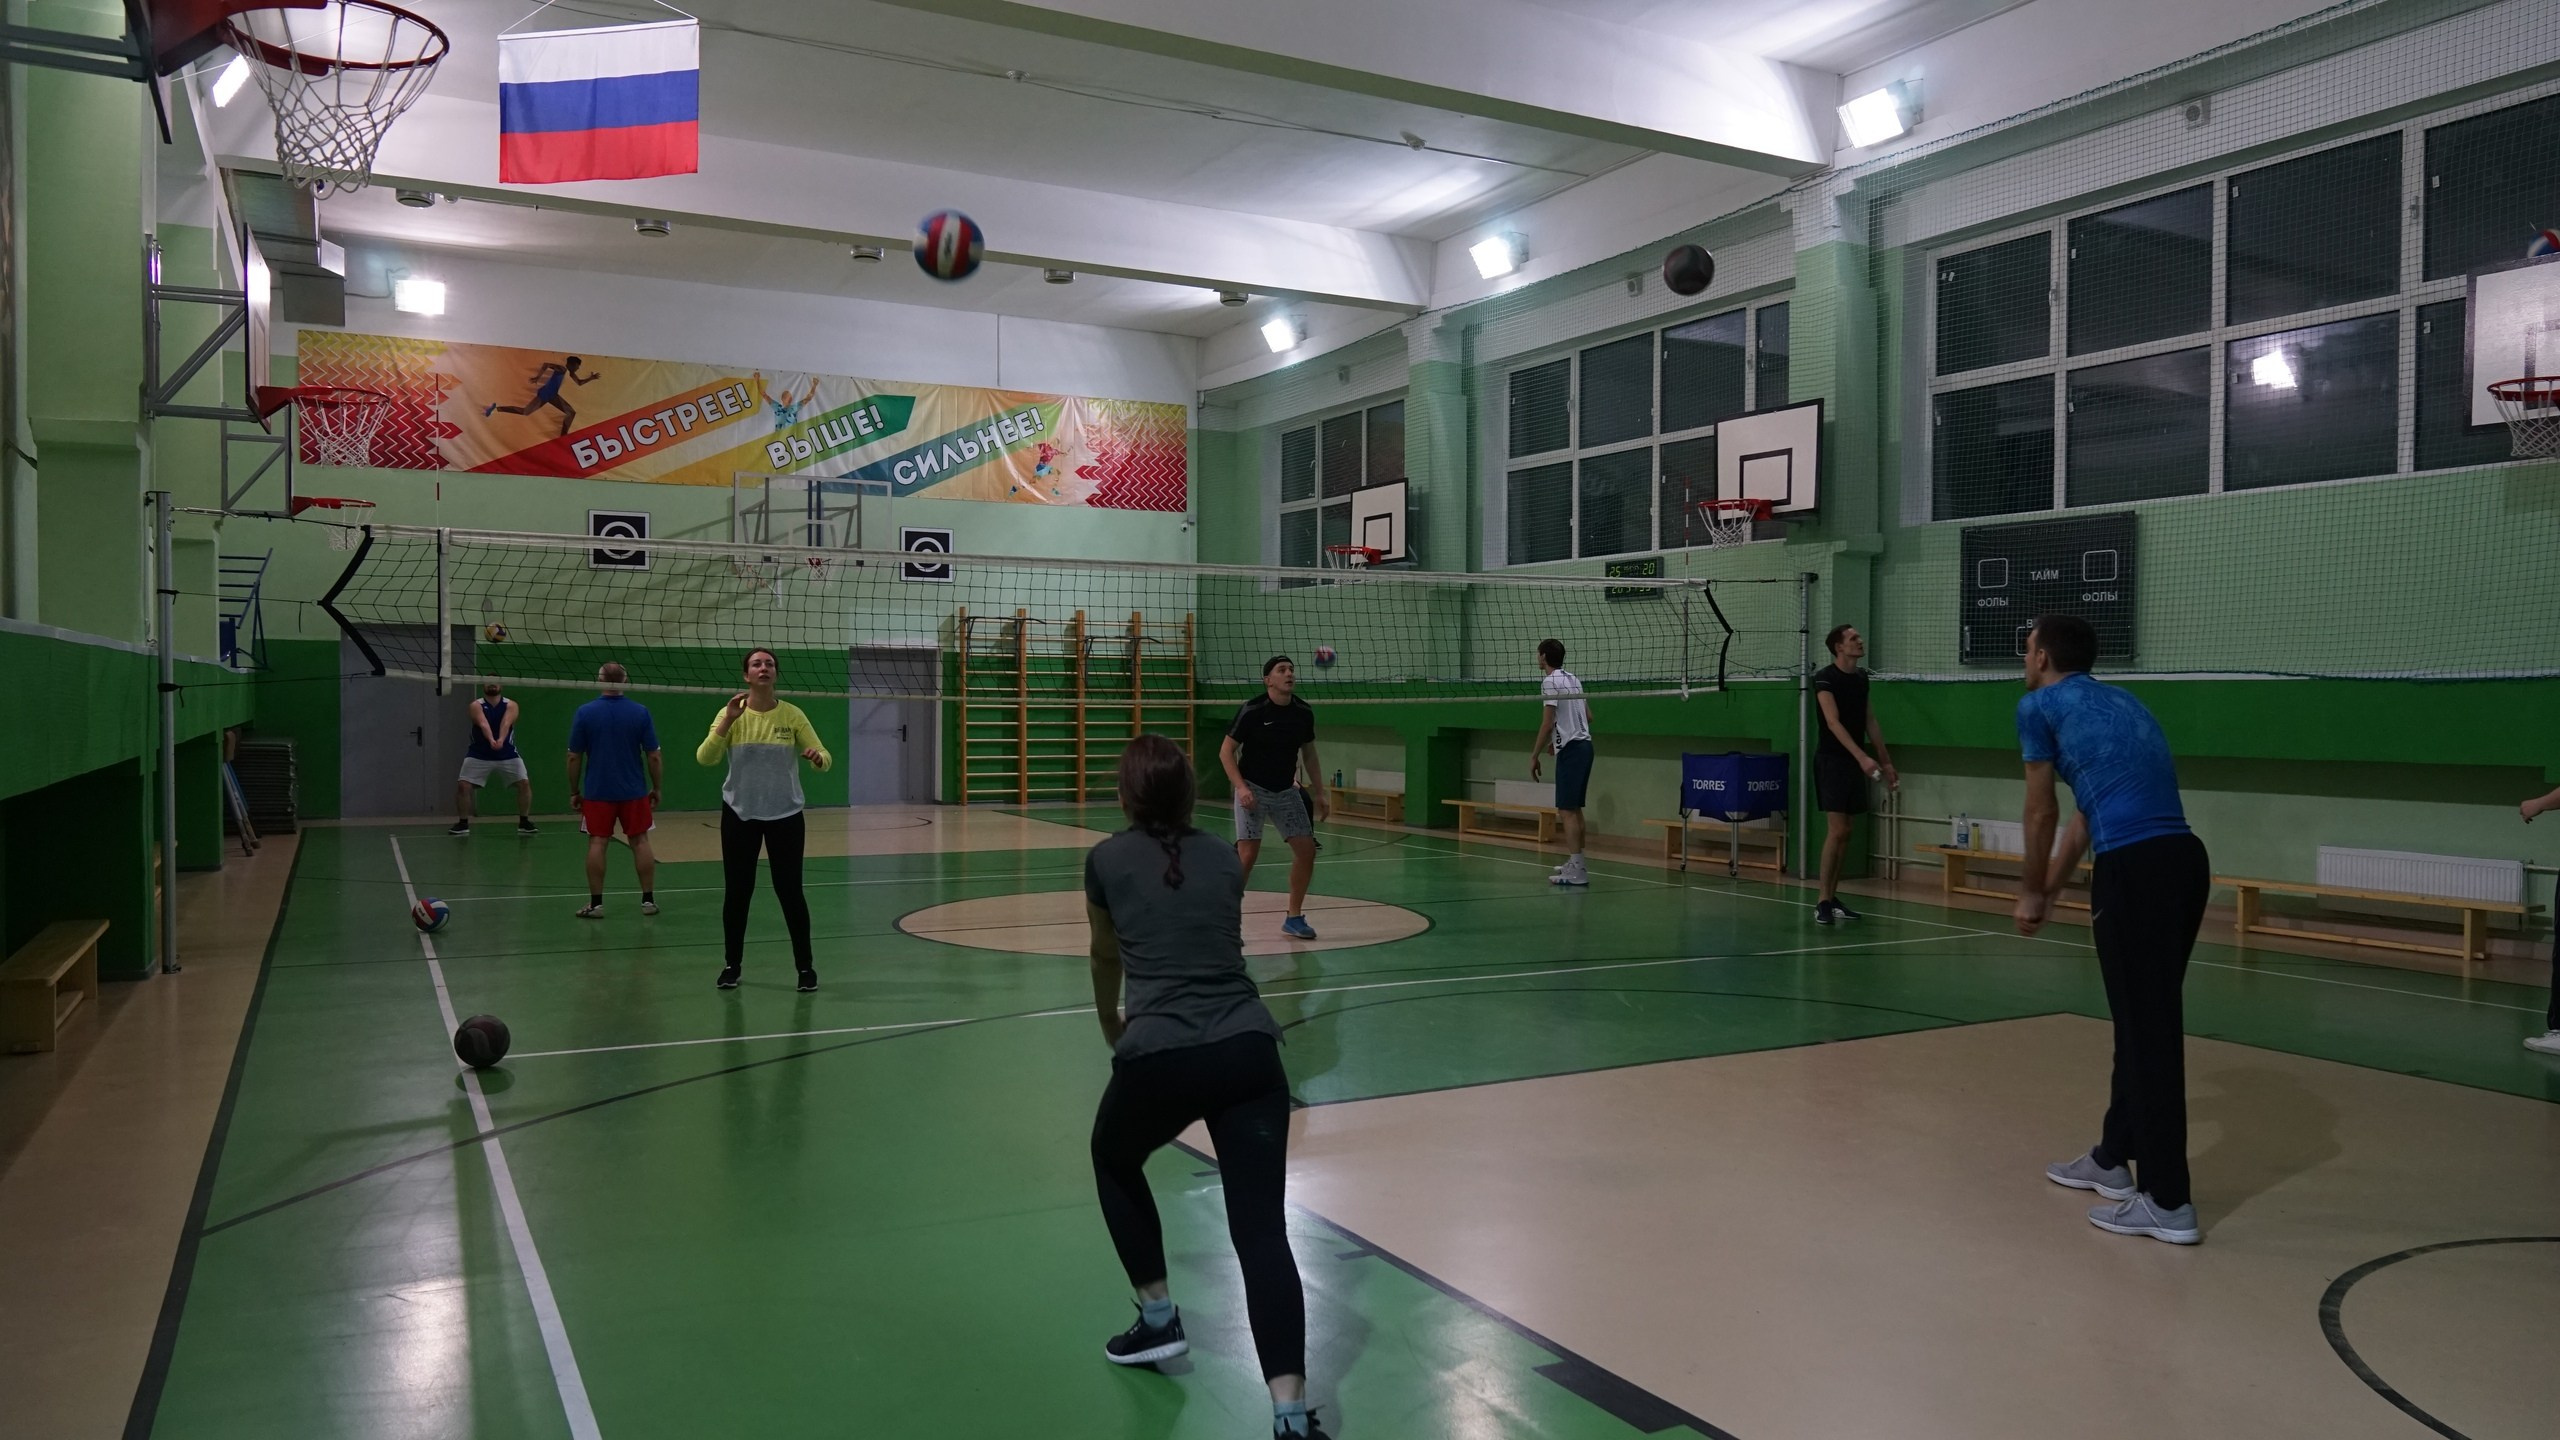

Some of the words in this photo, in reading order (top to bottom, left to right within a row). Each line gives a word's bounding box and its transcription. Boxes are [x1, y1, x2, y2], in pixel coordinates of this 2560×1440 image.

[571, 383, 752, 469] БЫСТРЕЕ!
[765, 404, 884, 469] ВЫШЕ!
[893, 407, 1044, 485] СИЛЬНЕЕ!
[1642, 563, 1655, 575] 20
[2030, 569, 2059, 581] ТАЙМ
[1977, 597, 2009, 607] ФОЛЫ
[2082, 591, 2118, 602] ФОЛЫ
[1692, 778, 1726, 791] TORRES
[1746, 780, 1780, 792] TORRES
